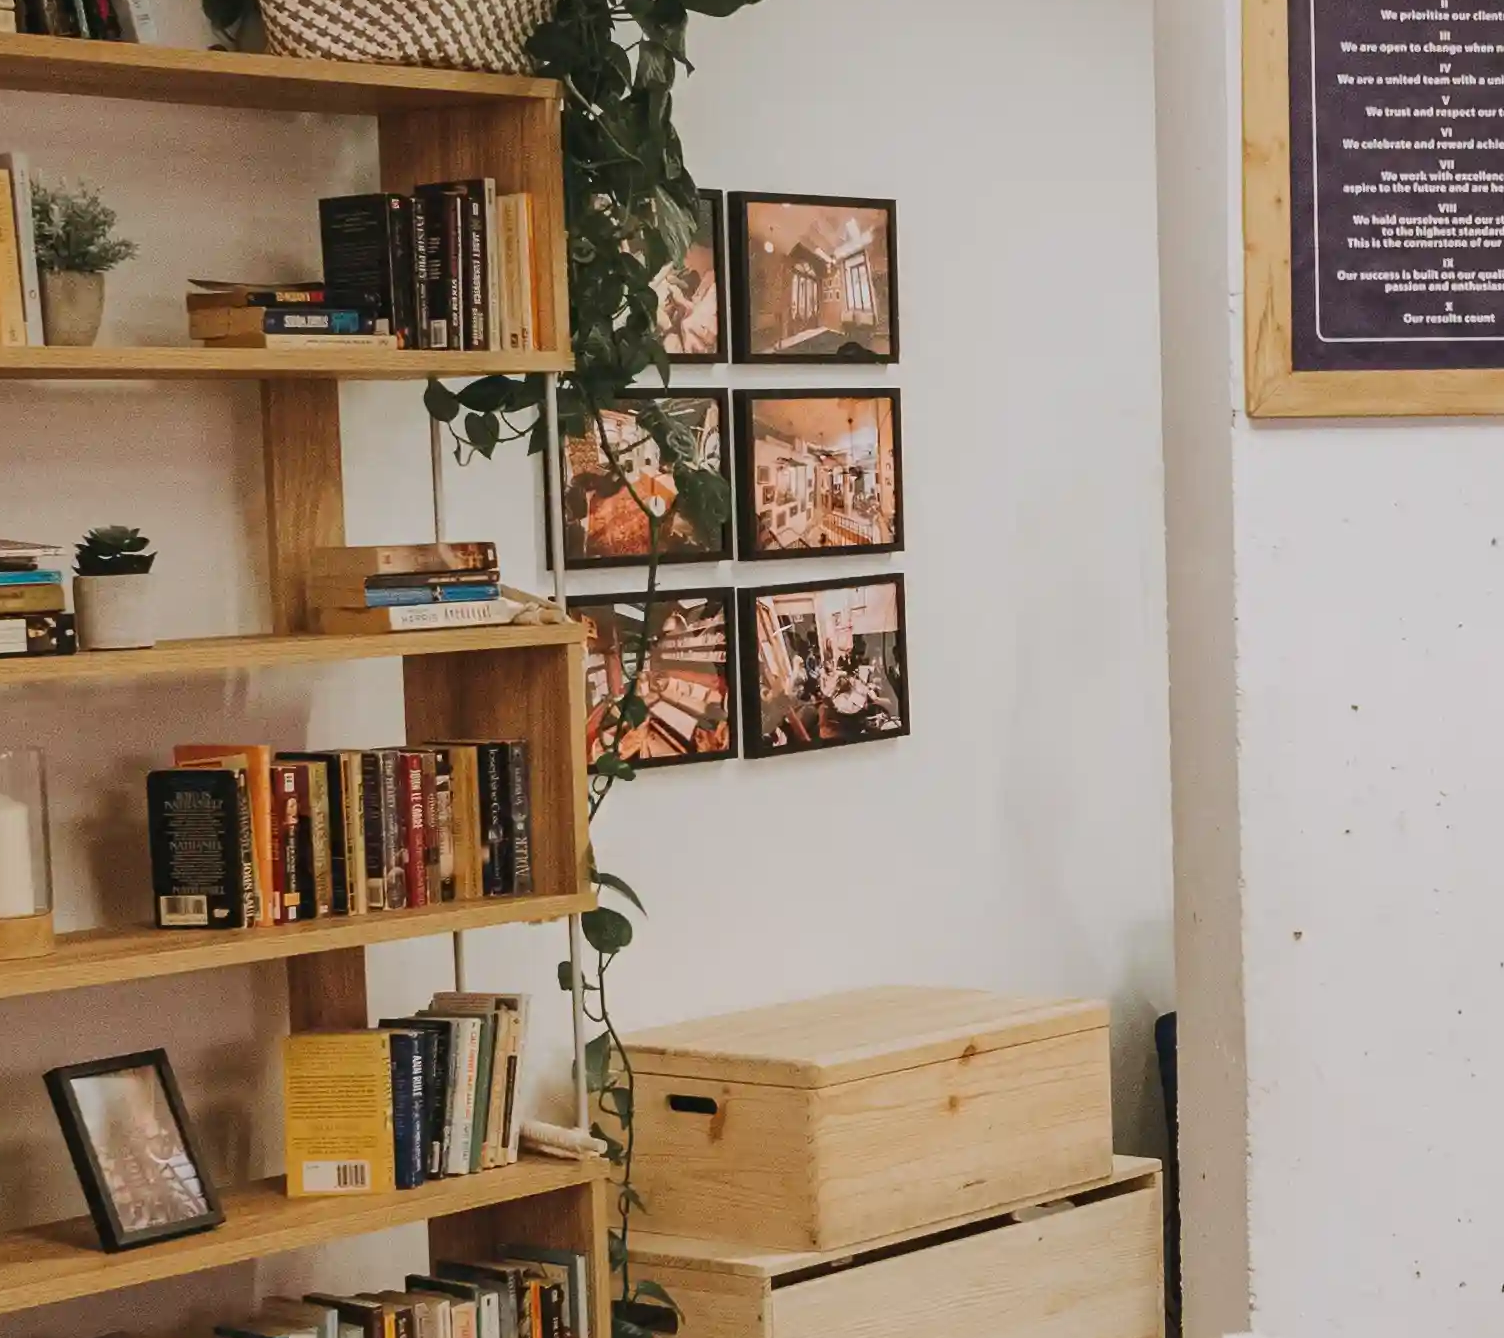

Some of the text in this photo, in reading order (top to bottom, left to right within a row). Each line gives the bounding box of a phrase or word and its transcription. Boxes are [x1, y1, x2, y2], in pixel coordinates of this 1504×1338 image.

[1381, 9, 1398, 20] We
[1400, 9, 1450, 22] prioritise
[1451, 12, 1471, 21] our
[1340, 42, 1358, 53] We
[1359, 44, 1378, 52] are
[1379, 43, 1407, 54] open
[1409, 43, 1421, 53] to
[1423, 42, 1462, 55] change
[1464, 42, 1494, 53] when
[1337, 74, 1355, 85] We
[1356, 76, 1374, 84] are
[1385, 74, 1421, 85] united
[1423, 75, 1451, 85] team
[1452, 74, 1476, 85] with
[1365, 106, 1383, 117] We
[1384, 107, 1411, 117] trust
[1413, 106, 1434, 117] and
[1436, 107, 1476, 119] respect
[1478, 109, 1497, 117] our
[488, 749, 500, 801] Josephine
[515, 837, 529, 877] ADLER
[412, 1055, 422, 1097] ANN RULE
